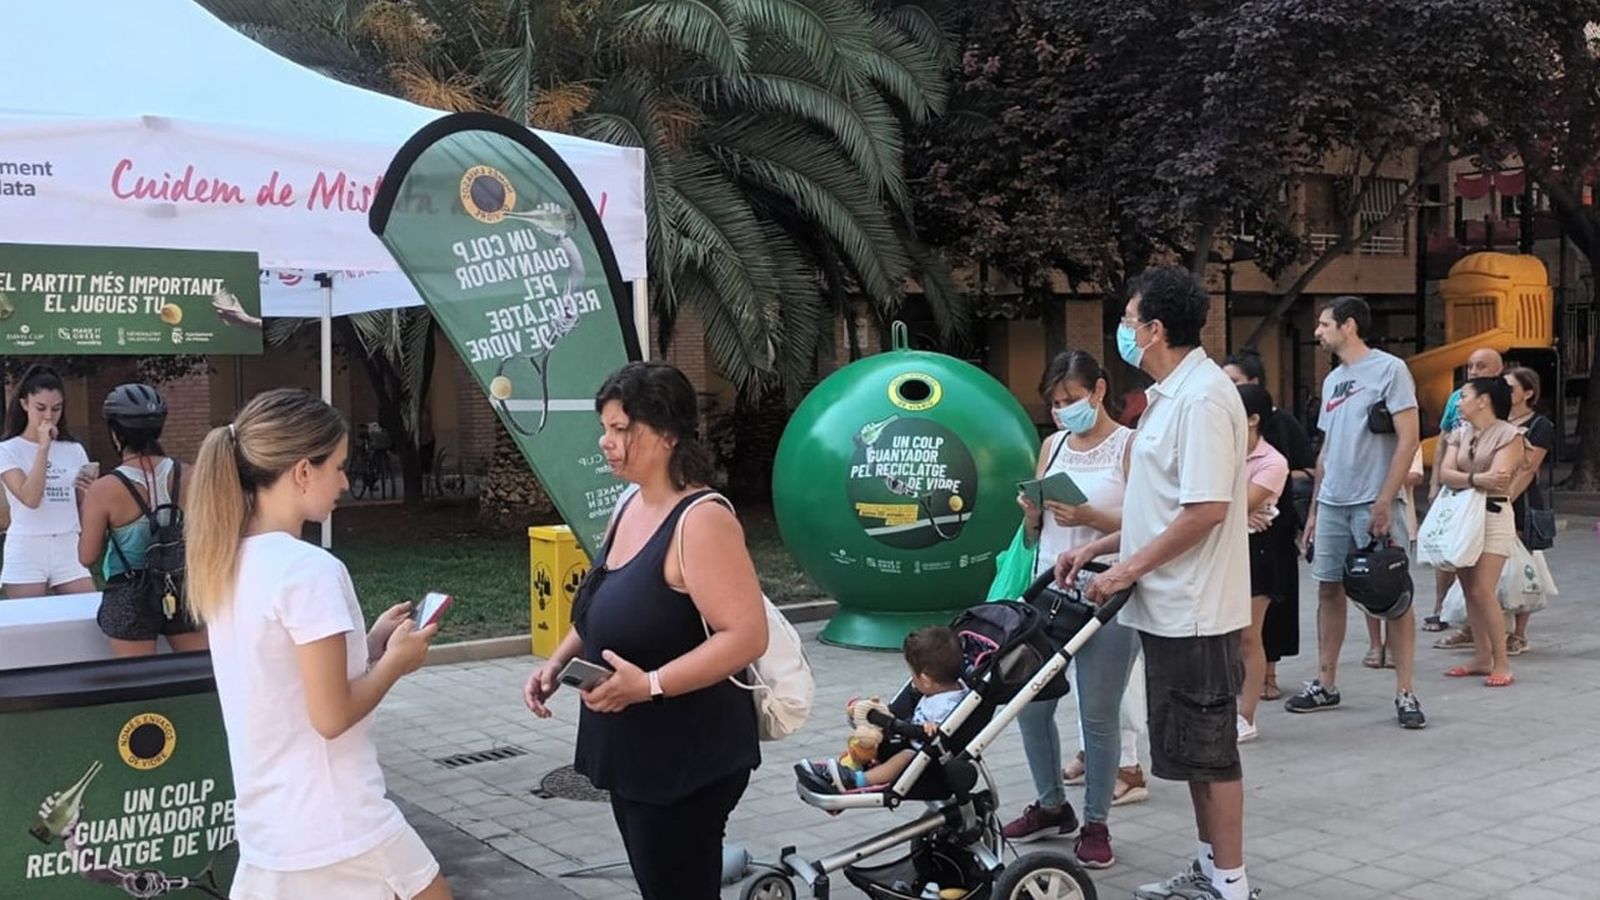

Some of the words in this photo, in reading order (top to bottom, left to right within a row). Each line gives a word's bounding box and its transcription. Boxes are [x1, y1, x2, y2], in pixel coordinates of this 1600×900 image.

[0, 161, 53, 176] ment
[111, 158, 244, 203] Cuidem
[256, 171, 296, 207] de
[306, 171, 384, 213] Mis
[0, 272, 16, 291] EL
[21, 273, 86, 293] PARTIT
[90, 271, 125, 294] MÉS
[129, 276, 224, 296] IMPORTANT
[44, 294, 66, 313] EL
[71, 294, 138, 314] JUGUES
[143, 296, 165, 314] TU
[892, 436, 910, 448] UN
[912, 436, 944, 449] COLP
[867, 448, 938, 463] GUANYADOR
[850, 465, 872, 478] PEL
[875, 463, 947, 478] RECICLATGE
[907, 477, 924, 490] DE
[926, 477, 961, 493] VIDRE
[124, 788, 155, 813] UN
[160, 779, 214, 808] COLP
[74, 805, 205, 846] GUANYADOR
[211, 800, 236, 824] PE
[26, 838, 164, 878] RECICLATGE
[173, 832, 200, 858] DE
[206, 826, 237, 851] VID
